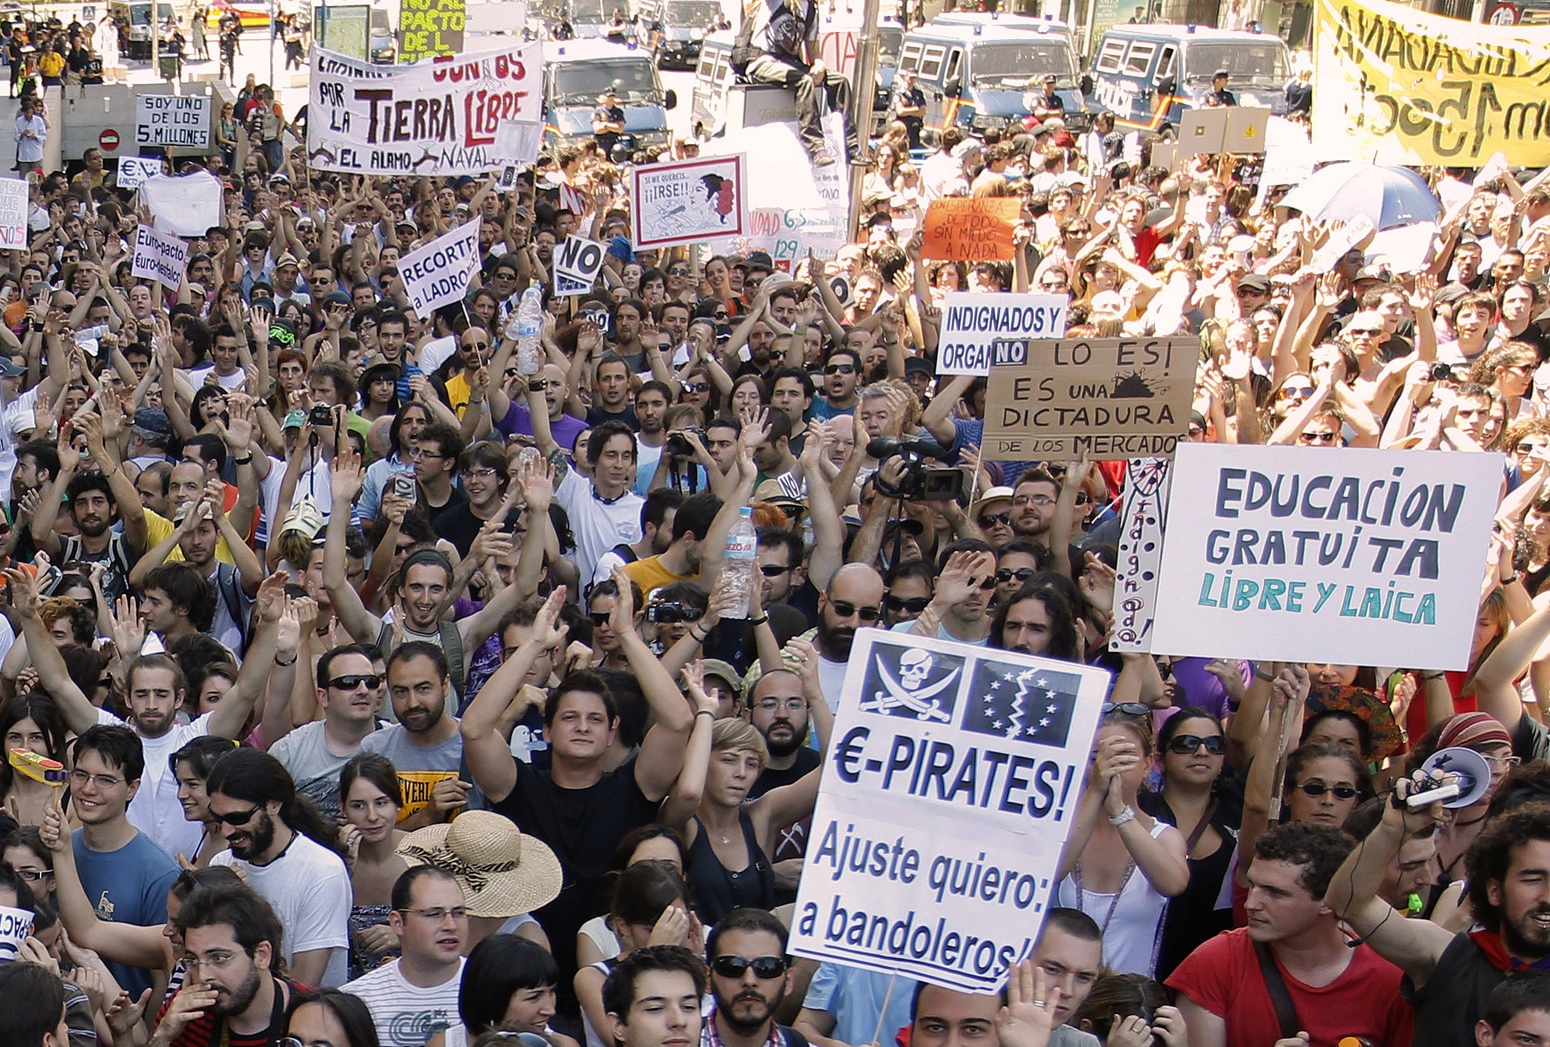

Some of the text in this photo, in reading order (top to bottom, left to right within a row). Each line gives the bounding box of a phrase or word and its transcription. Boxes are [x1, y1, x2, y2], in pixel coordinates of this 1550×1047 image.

[401, 9, 465, 31] PACTO
[145, 97, 202, 110] SOY UNO
[152, 112, 200, 124] DE LOS
[320, 82, 530, 148] POR TIERRA LIBRE
[330, 111, 350, 133] LA
[340, 149, 361, 168] EL
[371, 151, 413, 169] ALAMO
[934, 223, 997, 241] SIN MIEDO
[947, 214, 1000, 228] DE TODO
[559, 236, 602, 275] NO
[774, 239, 799, 259] 129
[945, 243, 999, 258] A NADA
[413, 297, 423, 310] a
[946, 306, 1062, 332] INDIGNADOS Y
[996, 341, 1024, 365] NO
[1054, 342, 1092, 366] LO
[1014, 378, 1108, 401] ES UNA
[1002, 404, 1175, 428] DICTADURA
[999, 441, 1022, 453] DE
[1032, 439, 1064, 452] LOS
[779, 473, 800, 499] NO
[1197, 569, 1307, 613] LIBRE
[1312, 582, 1337, 614] Y
[832, 726, 1076, 822] €-PIRATES!
[812, 820, 1050, 913] Ajuste quiero:
[799, 894, 1032, 978] a bandoleros!
